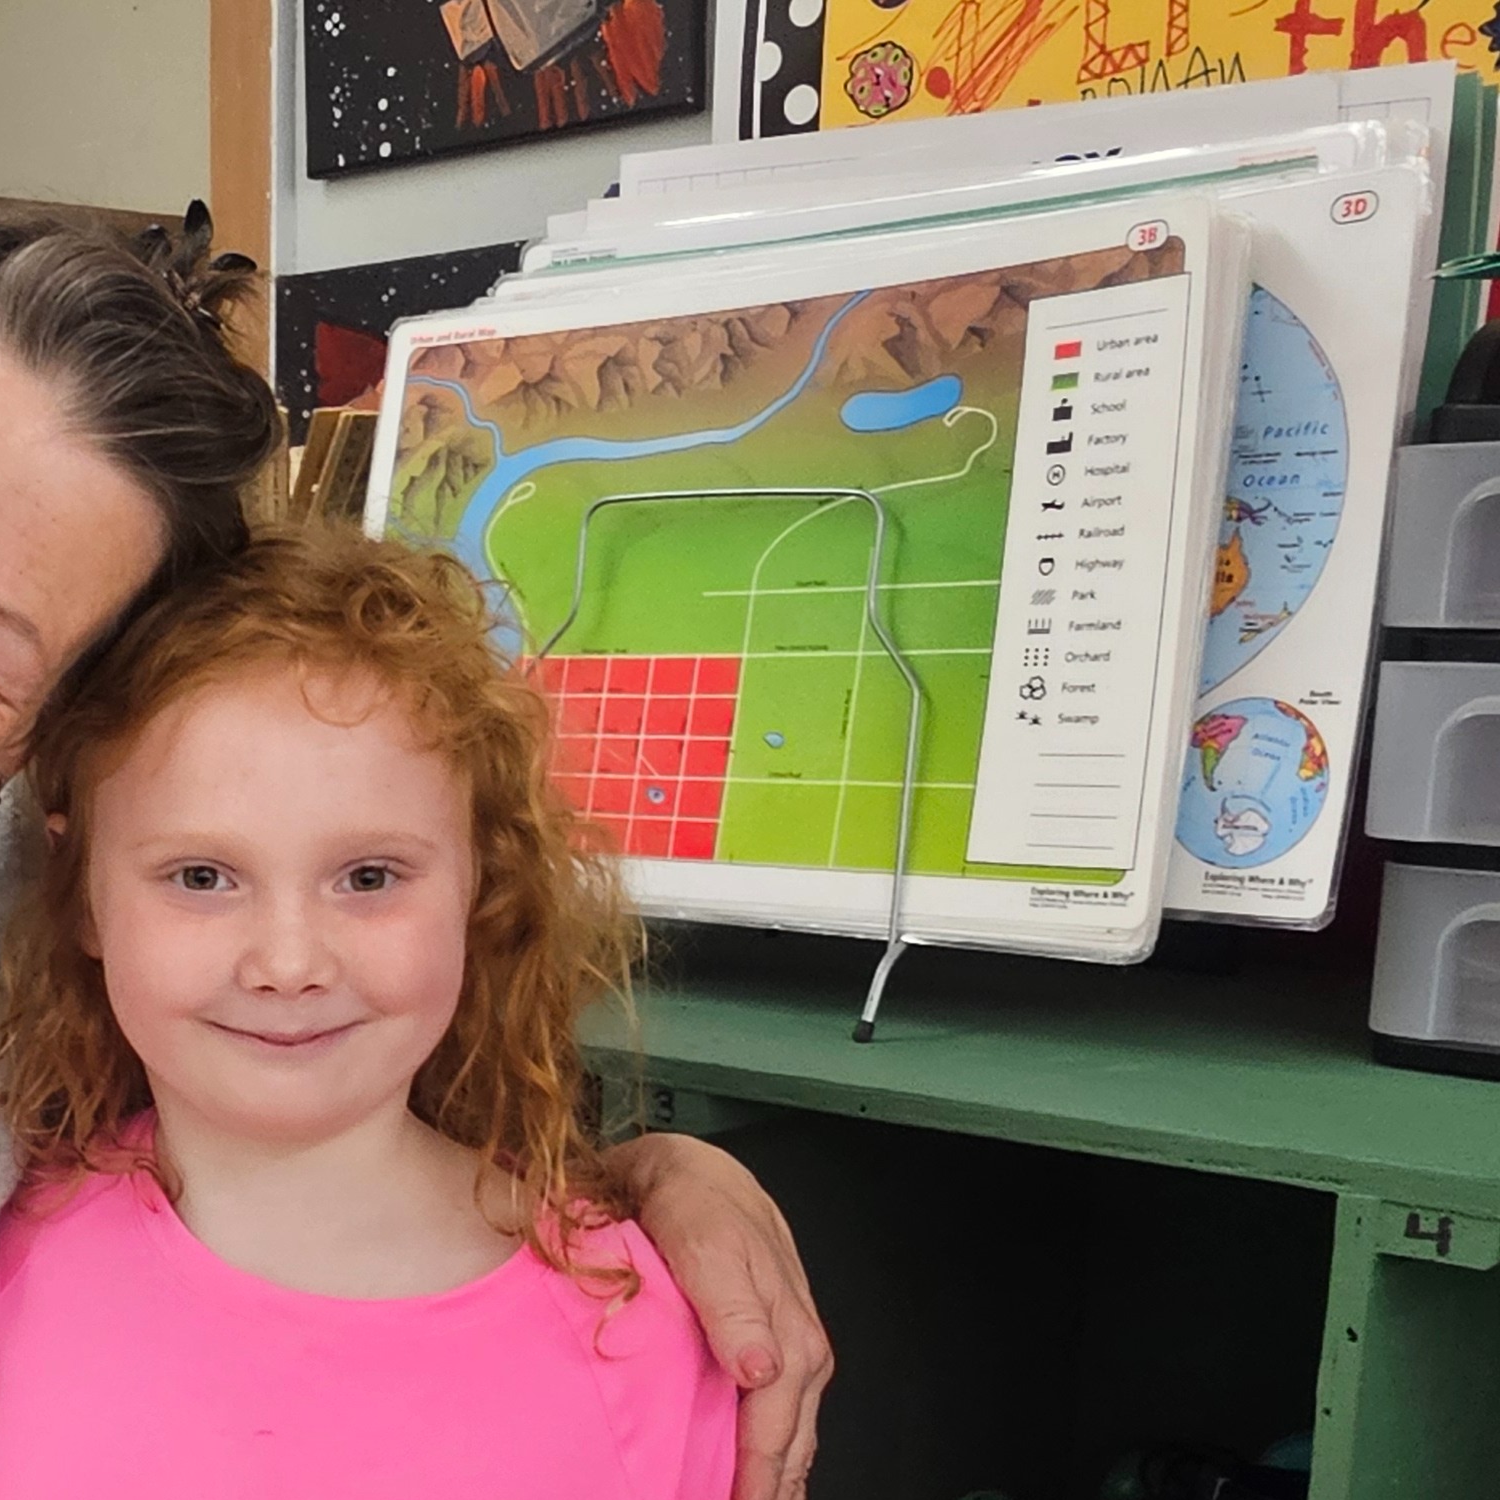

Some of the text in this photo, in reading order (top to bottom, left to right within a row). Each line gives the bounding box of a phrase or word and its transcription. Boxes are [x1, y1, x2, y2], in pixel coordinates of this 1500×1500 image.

[1341, 196, 1368, 218] 3D
[1136, 226, 1159, 246] 3B
[1097, 334, 1159, 351] Urban area
[1093, 367, 1150, 382] Rural area
[1091, 399, 1127, 415] School
[1262, 420, 1330, 439] Pacific
[1087, 433, 1128, 446] Factory
[1084, 462, 1130, 477] Hospital
[1242, 473, 1300, 487] Ocean
[1081, 495, 1122, 509] Airport
[1078, 525, 1125, 539] Railroad
[1075, 559, 1126, 572] Highway
[1071, 590, 1097, 600] Park
[1068, 620, 1122, 632] Farmland
[1064, 650, 1112, 663] Orchard
[1061, 682, 1096, 694] Forest
[1057, 713, 1100, 725] Swamp
[1403, 1212, 1455, 1257] 4
